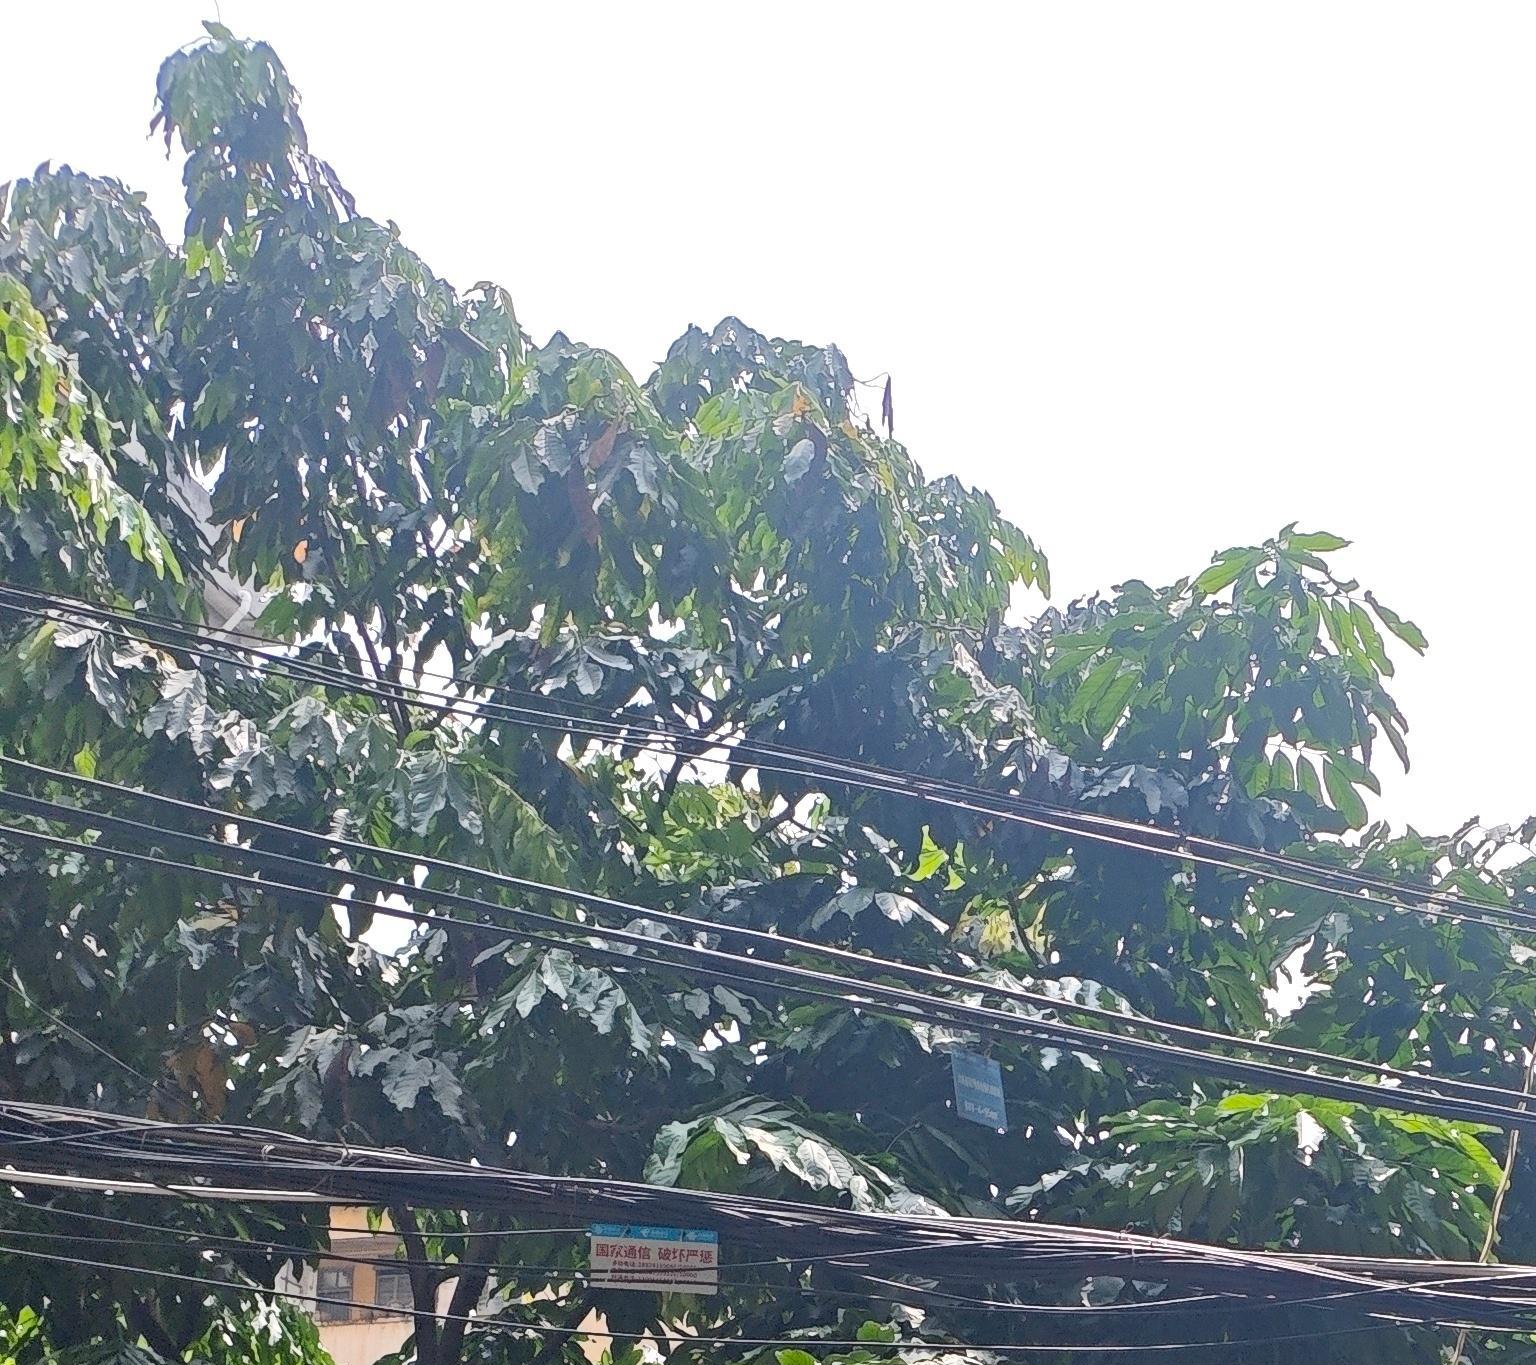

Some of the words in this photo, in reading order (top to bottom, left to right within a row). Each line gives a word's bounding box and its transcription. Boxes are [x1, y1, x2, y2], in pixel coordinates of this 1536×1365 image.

[596, 1243, 651, 1260] 国家通信
[658, 1247, 713, 1264] 破坏严惩
